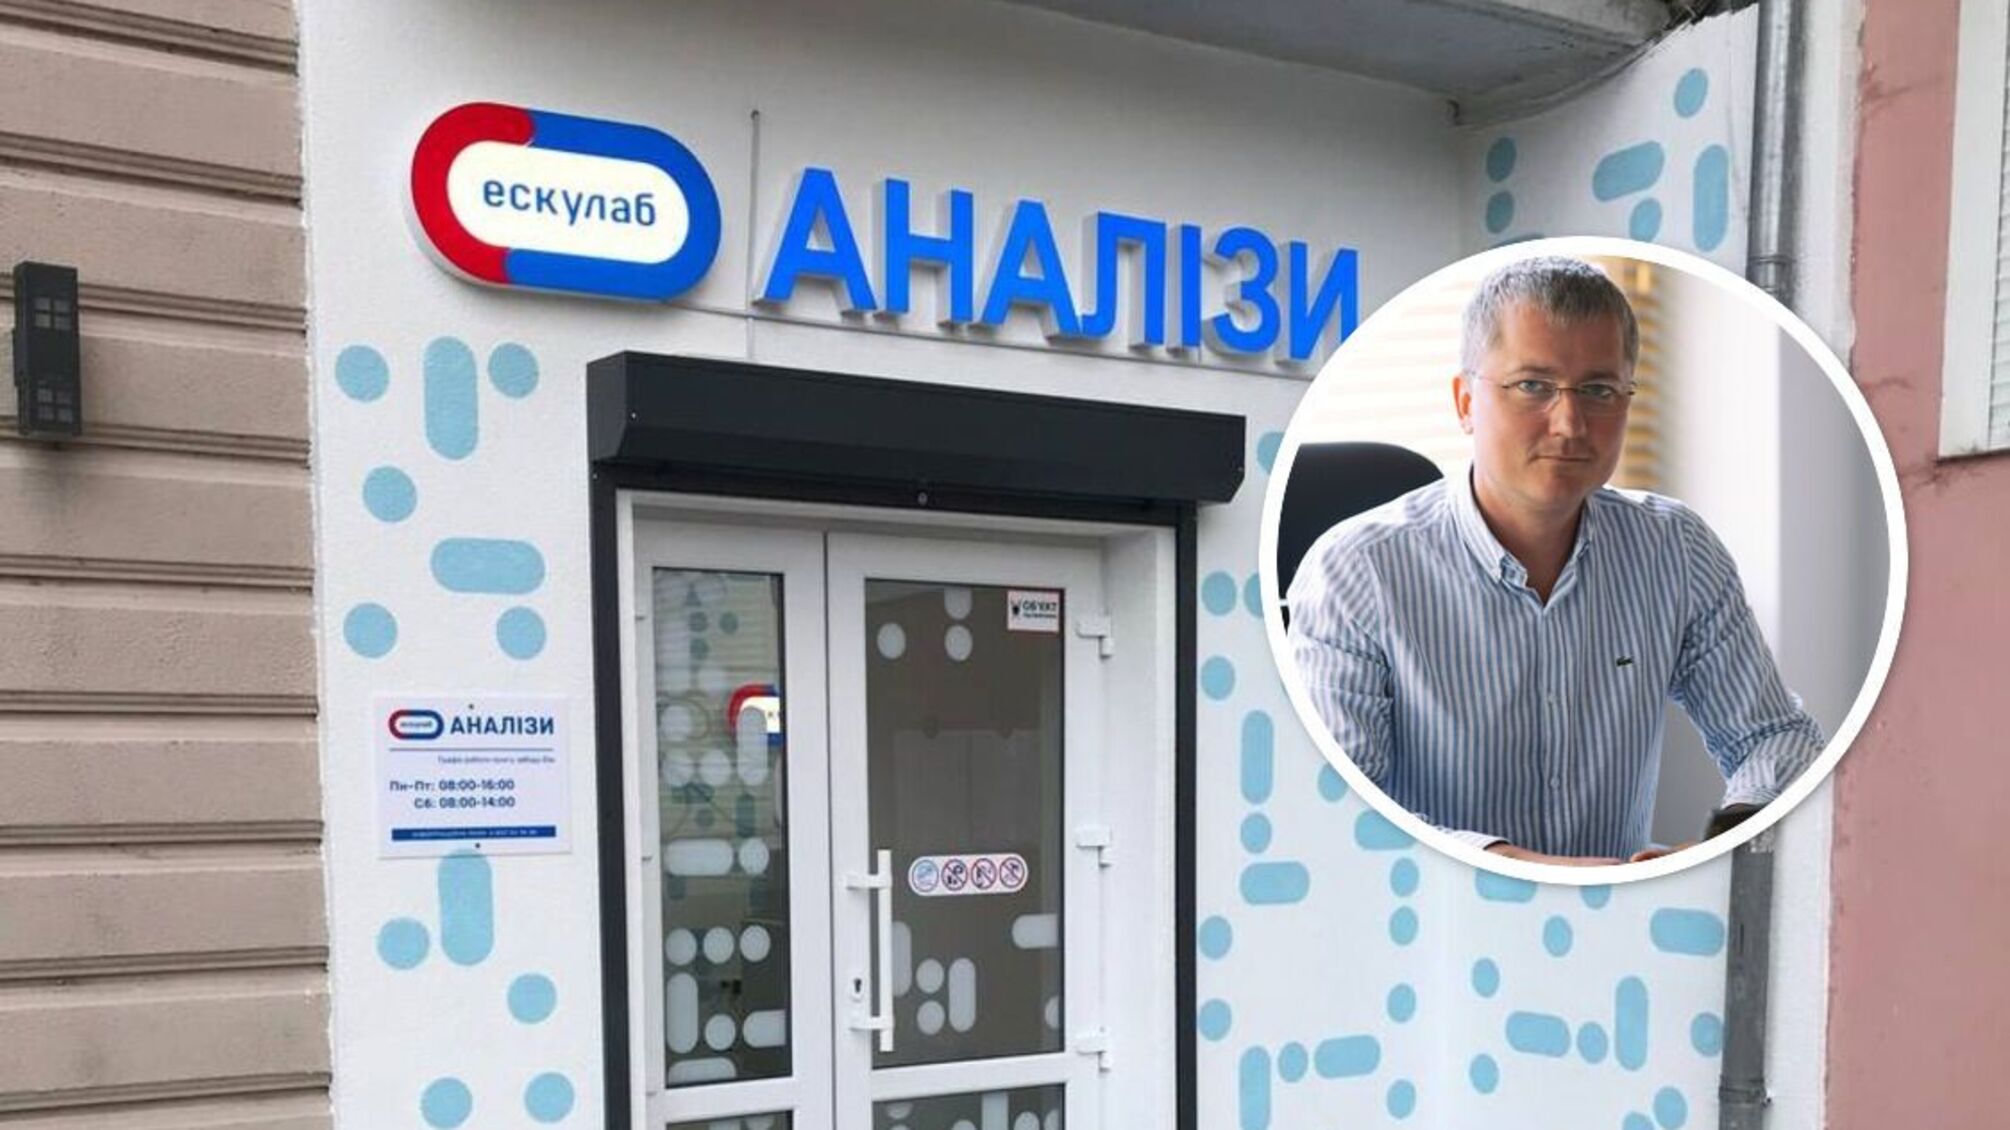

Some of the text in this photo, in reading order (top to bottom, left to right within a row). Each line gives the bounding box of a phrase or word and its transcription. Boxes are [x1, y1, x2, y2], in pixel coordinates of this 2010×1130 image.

[483, 180, 656, 226] ескулаб
[763, 168, 1358, 360] АНАЛІЗИ
[450, 716, 554, 735] АНАЛІЗИ
[389, 779, 515, 791] Пн-Пт: 08:00-16:00
[439, 796, 516, 808] 08:00-14:00
